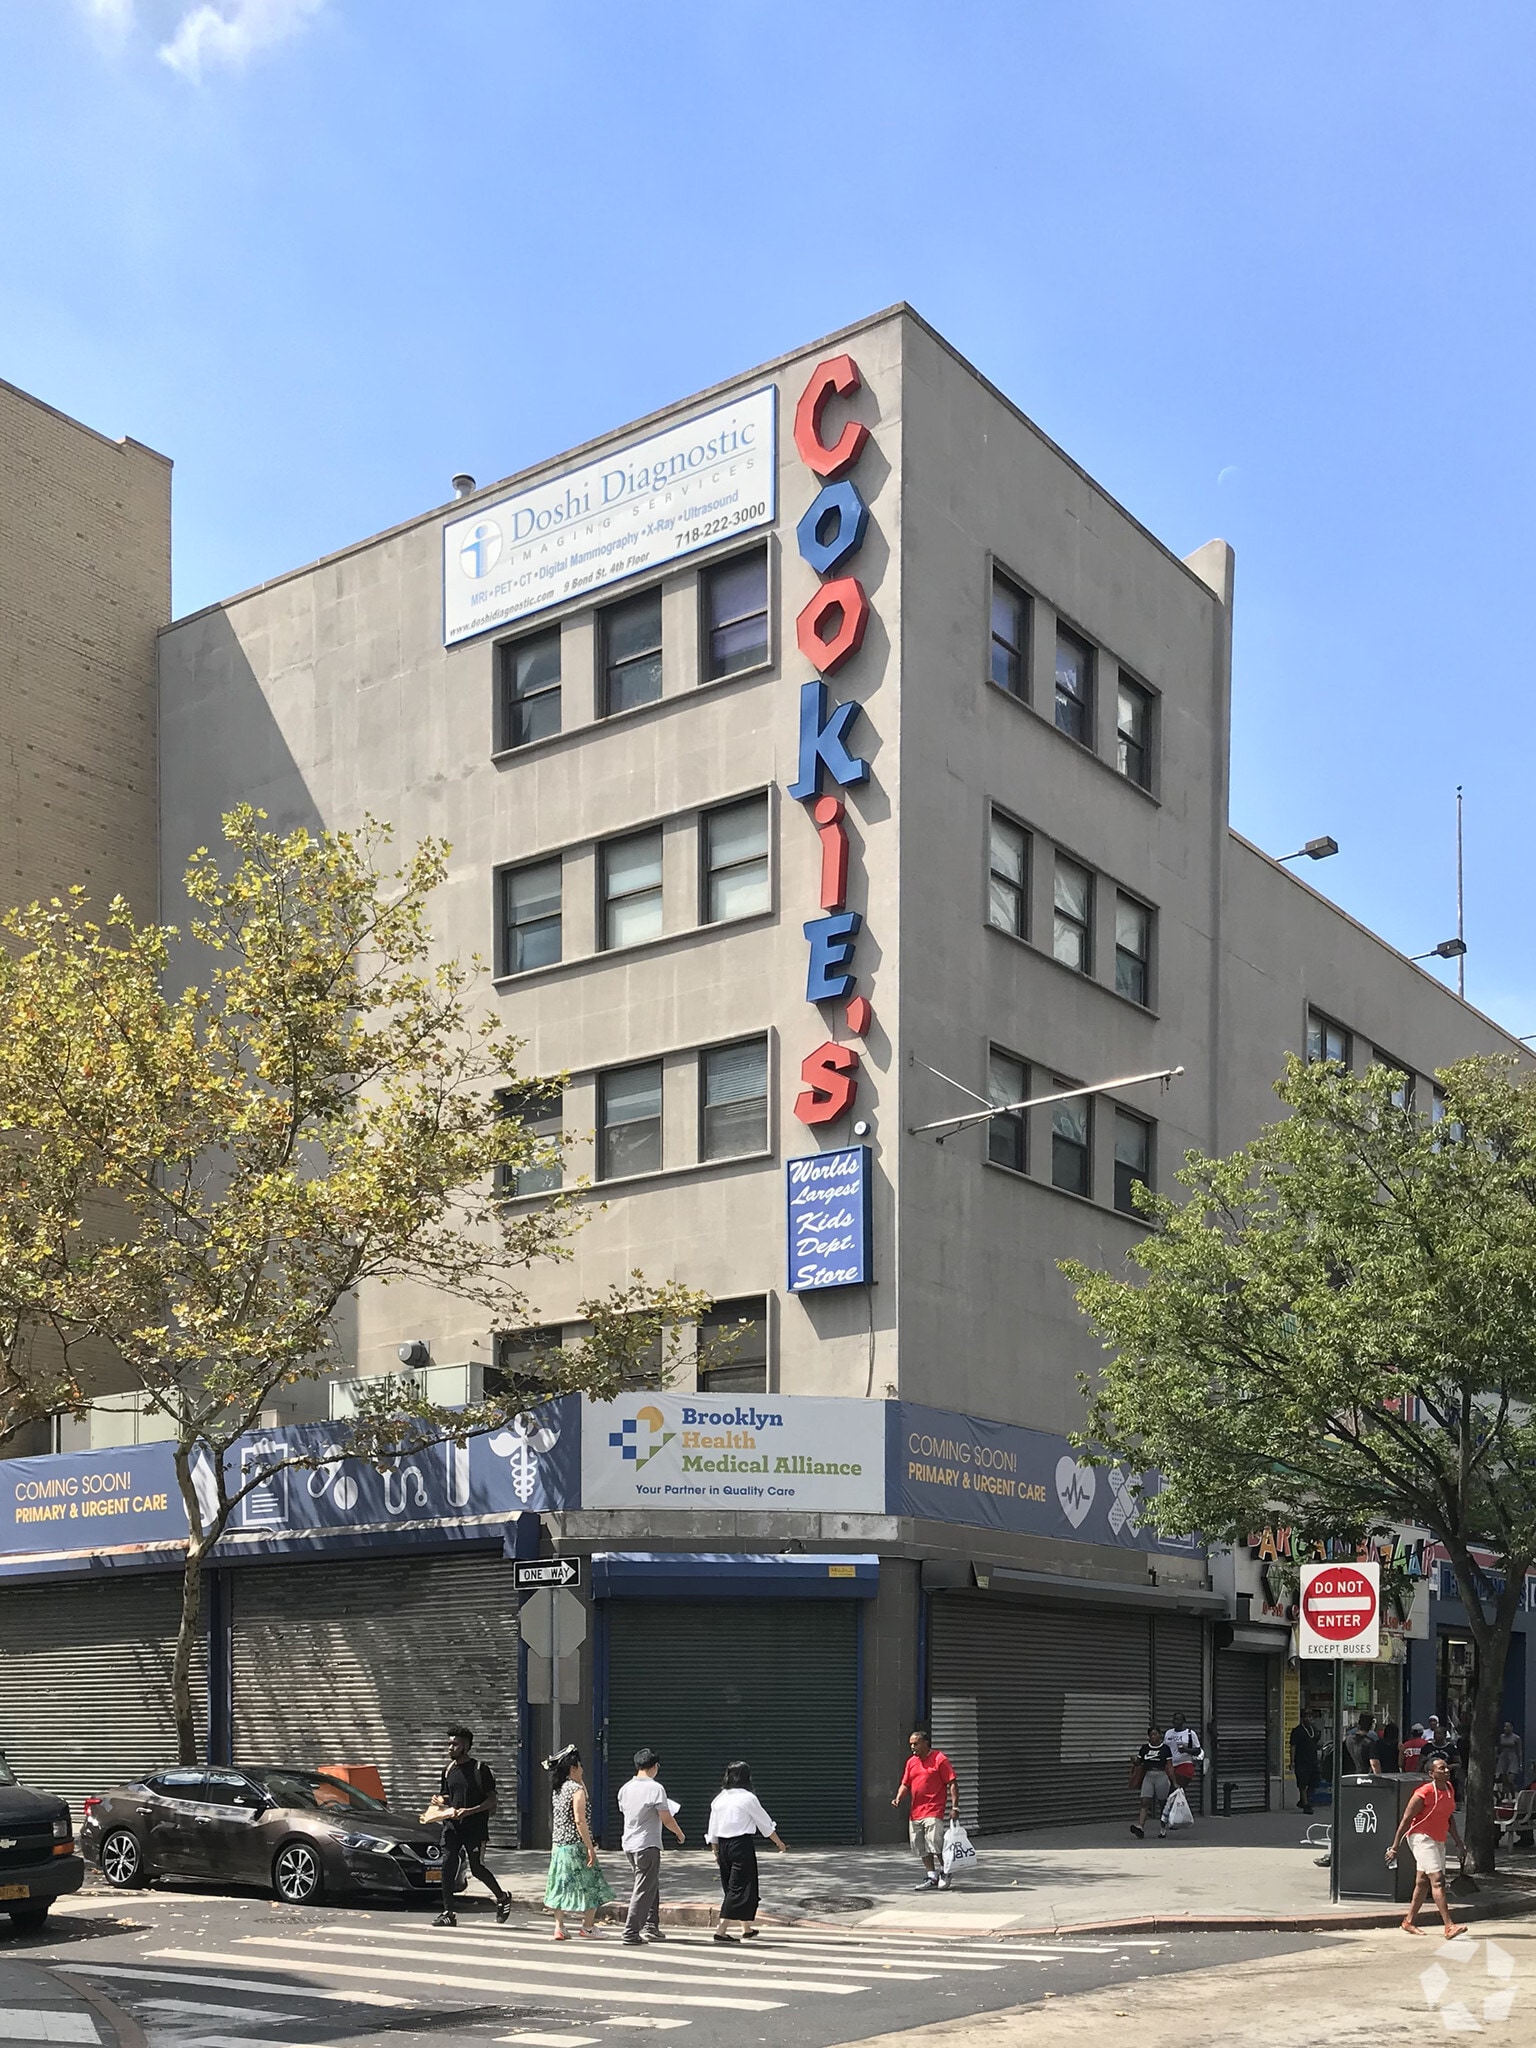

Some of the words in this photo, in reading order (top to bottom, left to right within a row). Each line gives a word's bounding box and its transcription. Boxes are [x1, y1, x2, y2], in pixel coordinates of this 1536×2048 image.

[511, 482, 591, 542] Doshi
[601, 419, 756, 505] Diagnostic
[511, 518, 611, 566] IMAGING
[632, 458, 754, 516] SERVICES
[675, 501, 766, 549] 718-222-3000
[471, 589, 488, 607] MRI
[494, 579, 513, 599] PET
[519, 571, 532, 588] CT
[539, 556, 568, 580] Digital
[570, 529, 639, 567] Mammography
[646, 516, 676, 537] X-Ray
[683, 489, 739, 522] Ultrasound
[449, 589, 555, 637] www.doshidiagnostic.com
[563, 582, 570, 593] 9
[571, 571, 593, 589] Bond
[595, 568, 608, 580] St.
[610, 559, 625, 576] 4th
[627, 552, 651, 570] Floor
[789, 1153, 860, 1184] Worlds
[790, 1179, 861, 1205] Largest
[796, 1208, 855, 1235] Kids
[796, 1234, 855, 1258] Dept.
[793, 1263, 858, 1289] Store
[681, 1407, 784, 1431] Brooklyn
[682, 1431, 756, 1449] Health
[908, 1432, 972, 1464] COMING
[974, 1445, 1018, 1473] SOON!
[682, 1454, 770, 1474] Medical
[774, 1456, 862, 1476] Alliance
[15, 1477, 79, 1502] COMING
[82, 1471, 131, 1495] SOON!
[636, 1484, 661, 1494] Your
[664, 1484, 706, 1495] Partner
[709, 1485, 719, 1495] in
[723, 1485, 764, 1497] Quality
[767, 1486, 795, 1497] Care
[908, 1461, 960, 1488] PRIMARY
[962, 1471, 971, 1489] &
[974, 1473, 1016, 1497] URGENT
[1018, 1482, 1046, 1503] CARE
[15, 1502, 66, 1523] PRIMARY
[69, 1502, 79, 1518] &
[81, 1497, 130, 1518] URGENT
[132, 1493, 168, 1513] CARE
[523, 1569, 543, 1581] ONE
[551, 1567, 570, 1579] WAY
[1315, 1581, 1333, 1594] DO
[1337, 1580, 1364, 1594] NOT
[1317, 1614, 1361, 1627] ENTER
[1308, 1644, 1340, 1654] EXCEPT
[1343, 1644, 1371, 1654] BUSES
